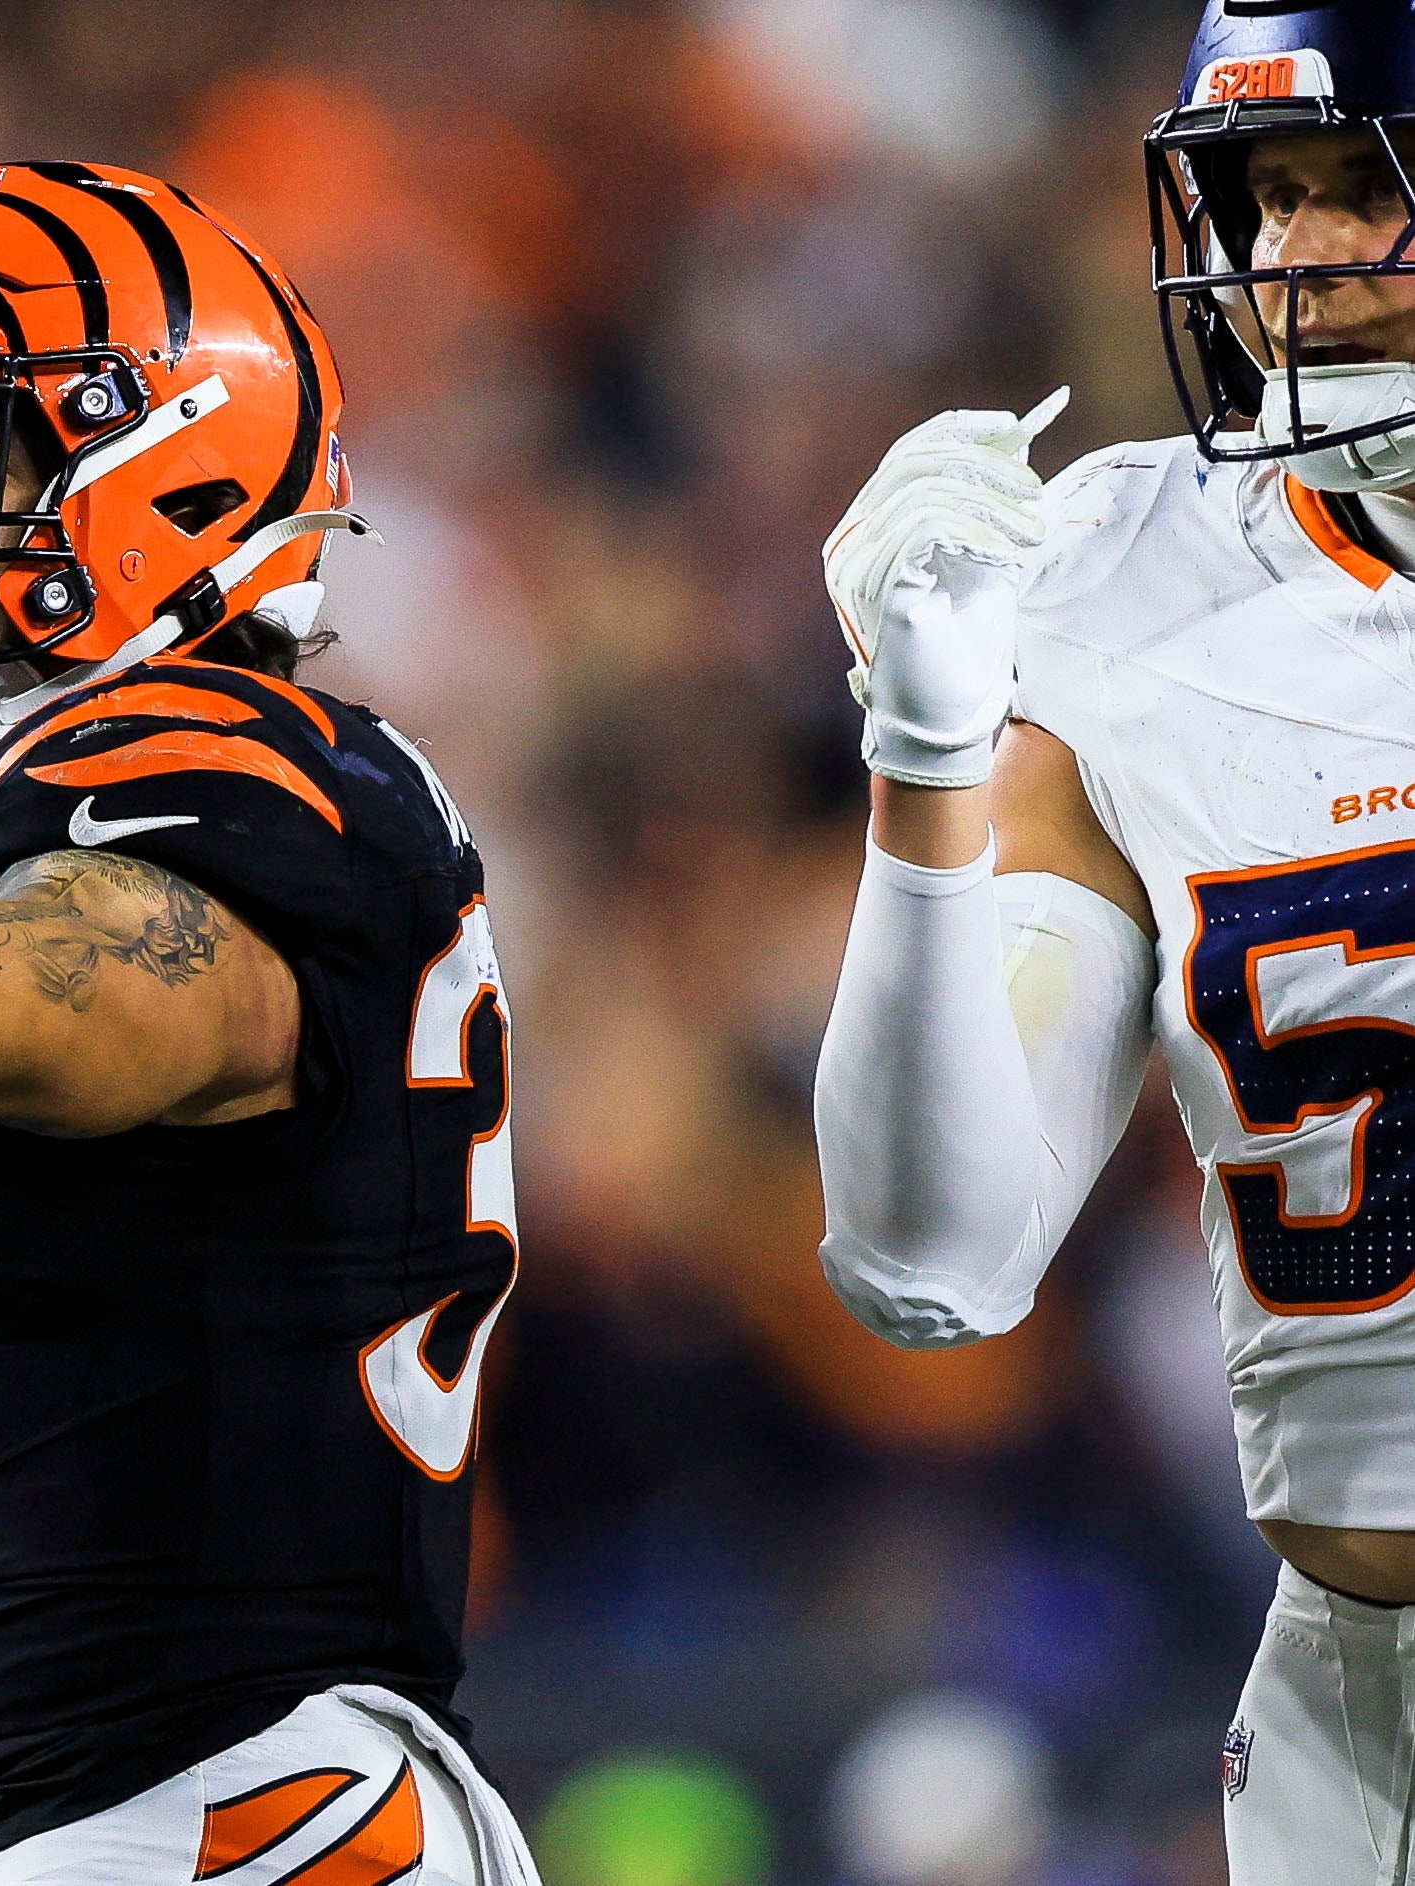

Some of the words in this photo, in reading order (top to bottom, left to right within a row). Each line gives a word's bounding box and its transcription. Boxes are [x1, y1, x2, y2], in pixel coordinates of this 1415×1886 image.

[1208, 57, 1294, 103] 5280
[359, 894, 519, 1482] 3
[1185, 838, 1415, 1316] 5
